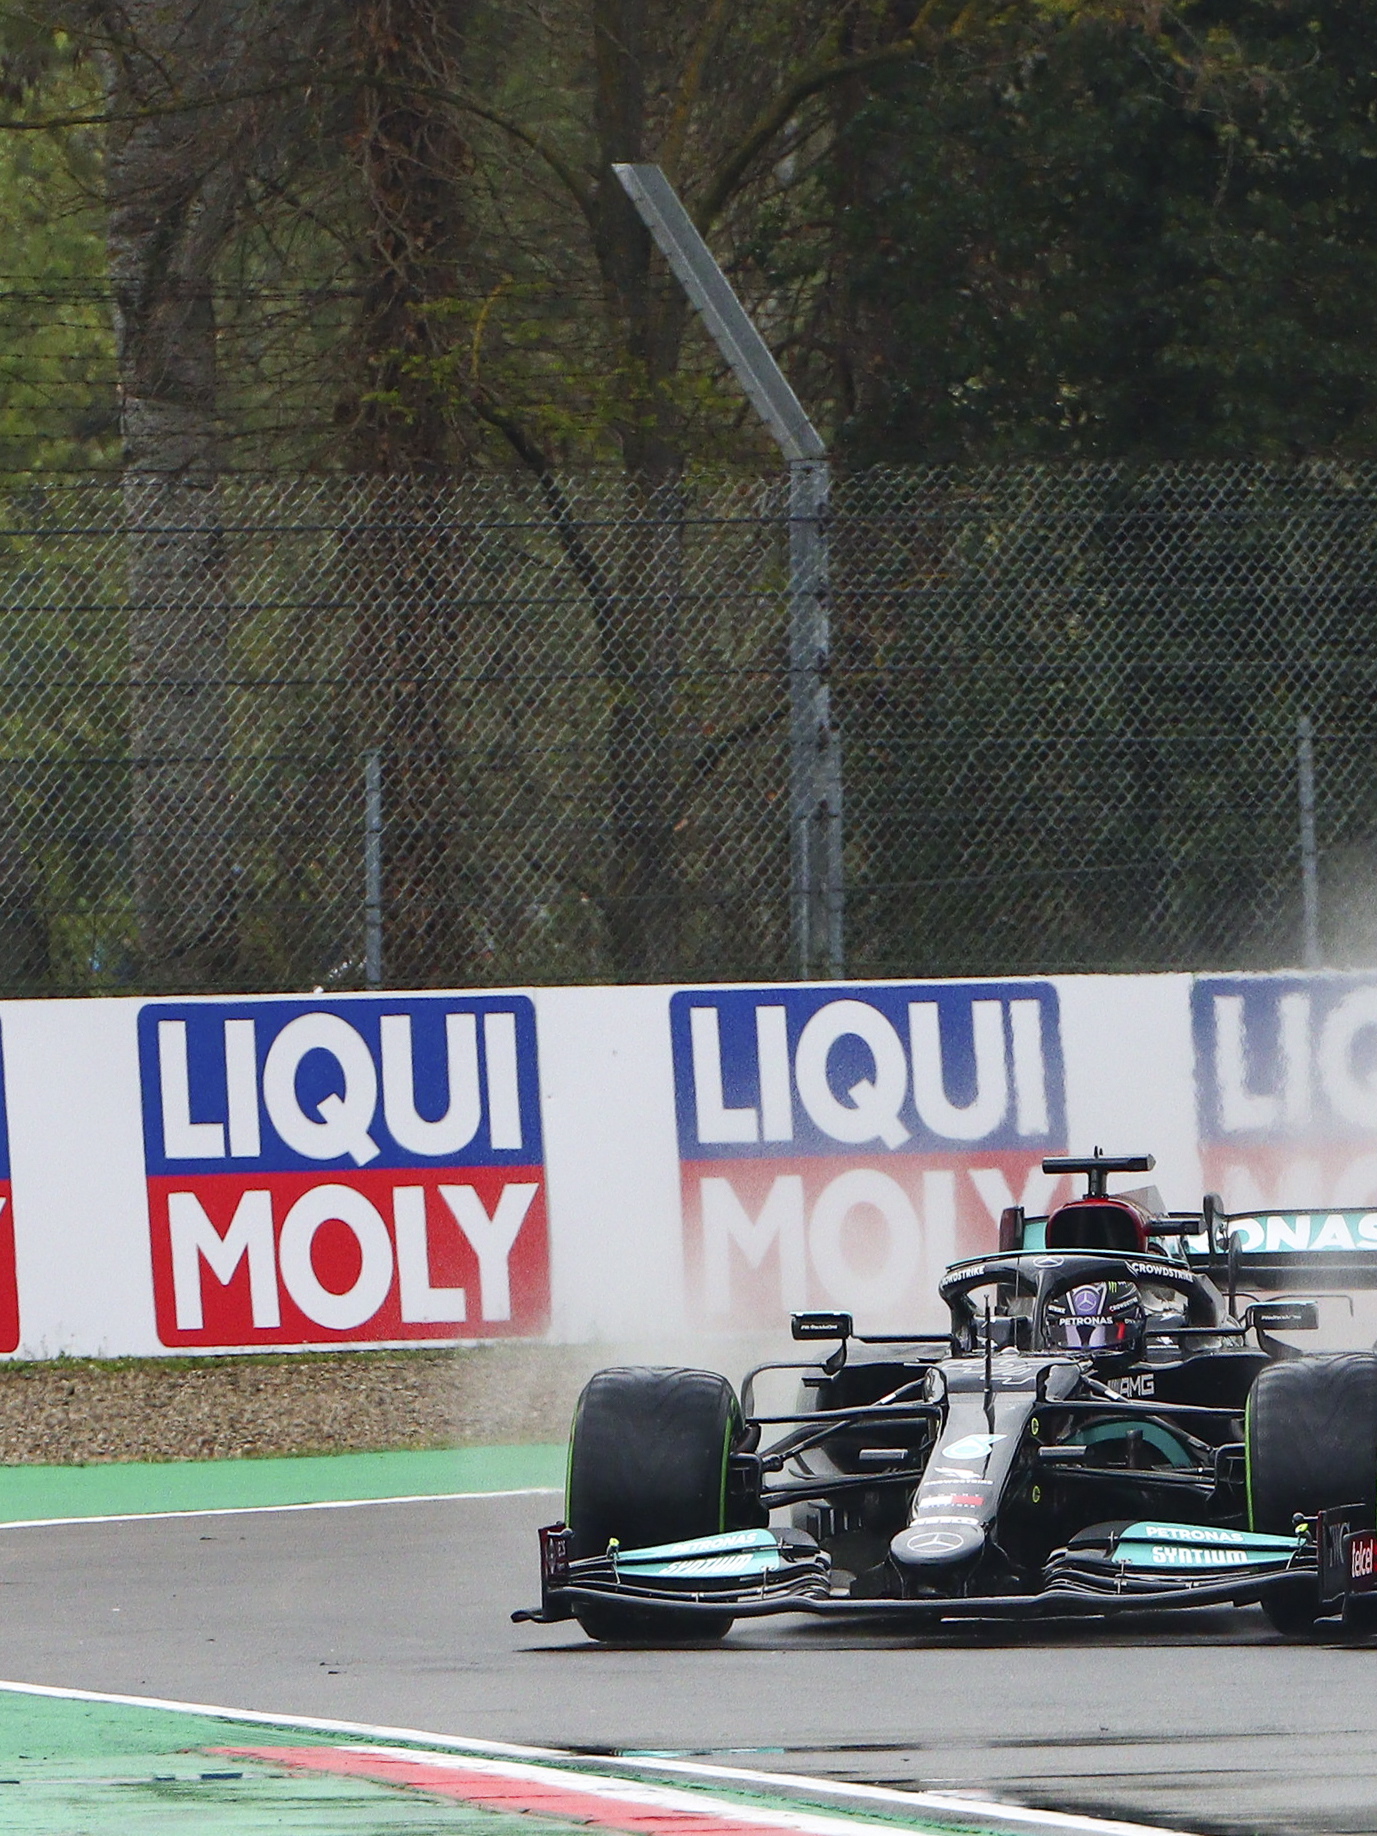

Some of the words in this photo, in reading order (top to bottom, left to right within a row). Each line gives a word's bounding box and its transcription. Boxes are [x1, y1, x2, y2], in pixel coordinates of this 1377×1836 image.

[158, 1011, 522, 1167] LIQUI
[690, 999, 1049, 1151] LIQUI
[167, 1182, 539, 1331] MOLY
[1059, 1316, 1114, 1326] PETRONAS
[1120, 1373, 1155, 1398] AMG
[670, 1532, 758, 1553] PETRONAS
[1145, 1525, 1245, 1542] PETRONAS
[1351, 1539, 1374, 1579] telcel
